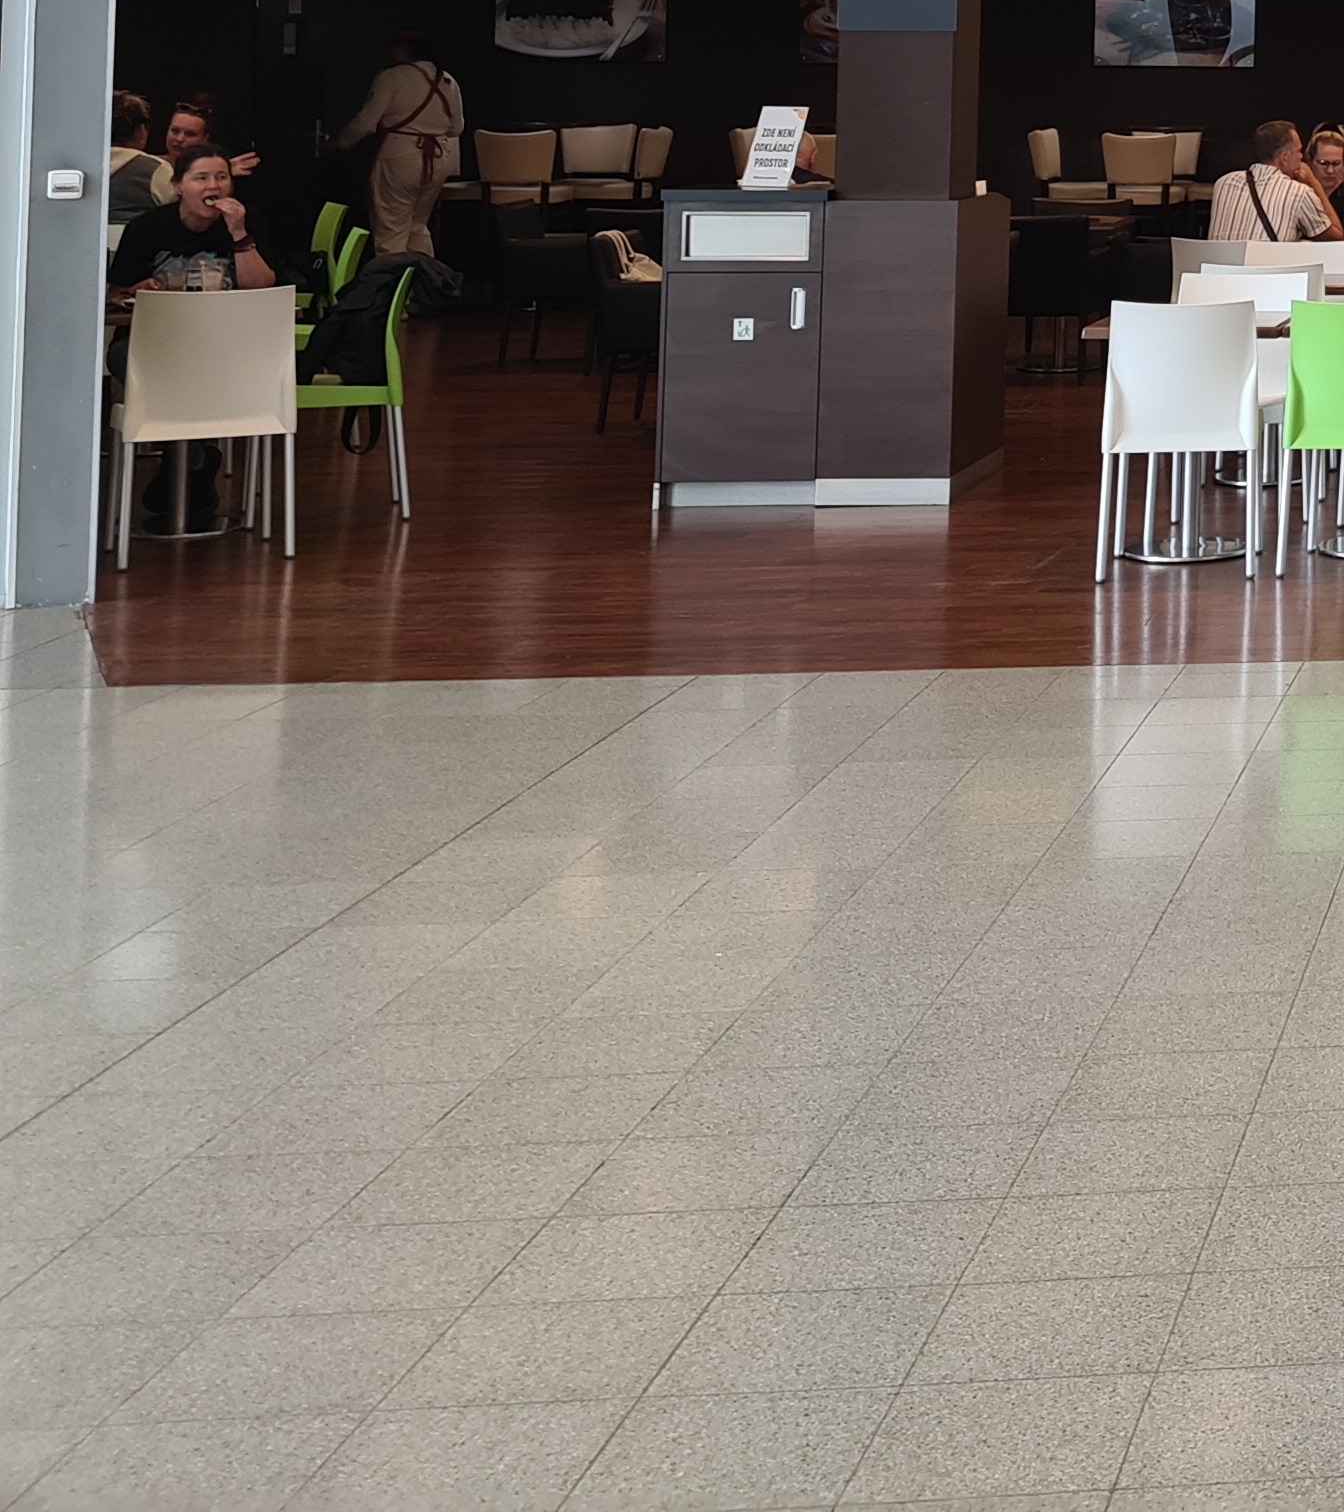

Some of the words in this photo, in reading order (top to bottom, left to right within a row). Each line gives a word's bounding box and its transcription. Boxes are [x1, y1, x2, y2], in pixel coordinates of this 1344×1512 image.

[761, 128, 776, 138] ZDE
[777, 126, 797, 138] NENÍ
[753, 141, 796, 153] ODKLÁDACÍ
[753, 157, 789, 168] PROSTOR
